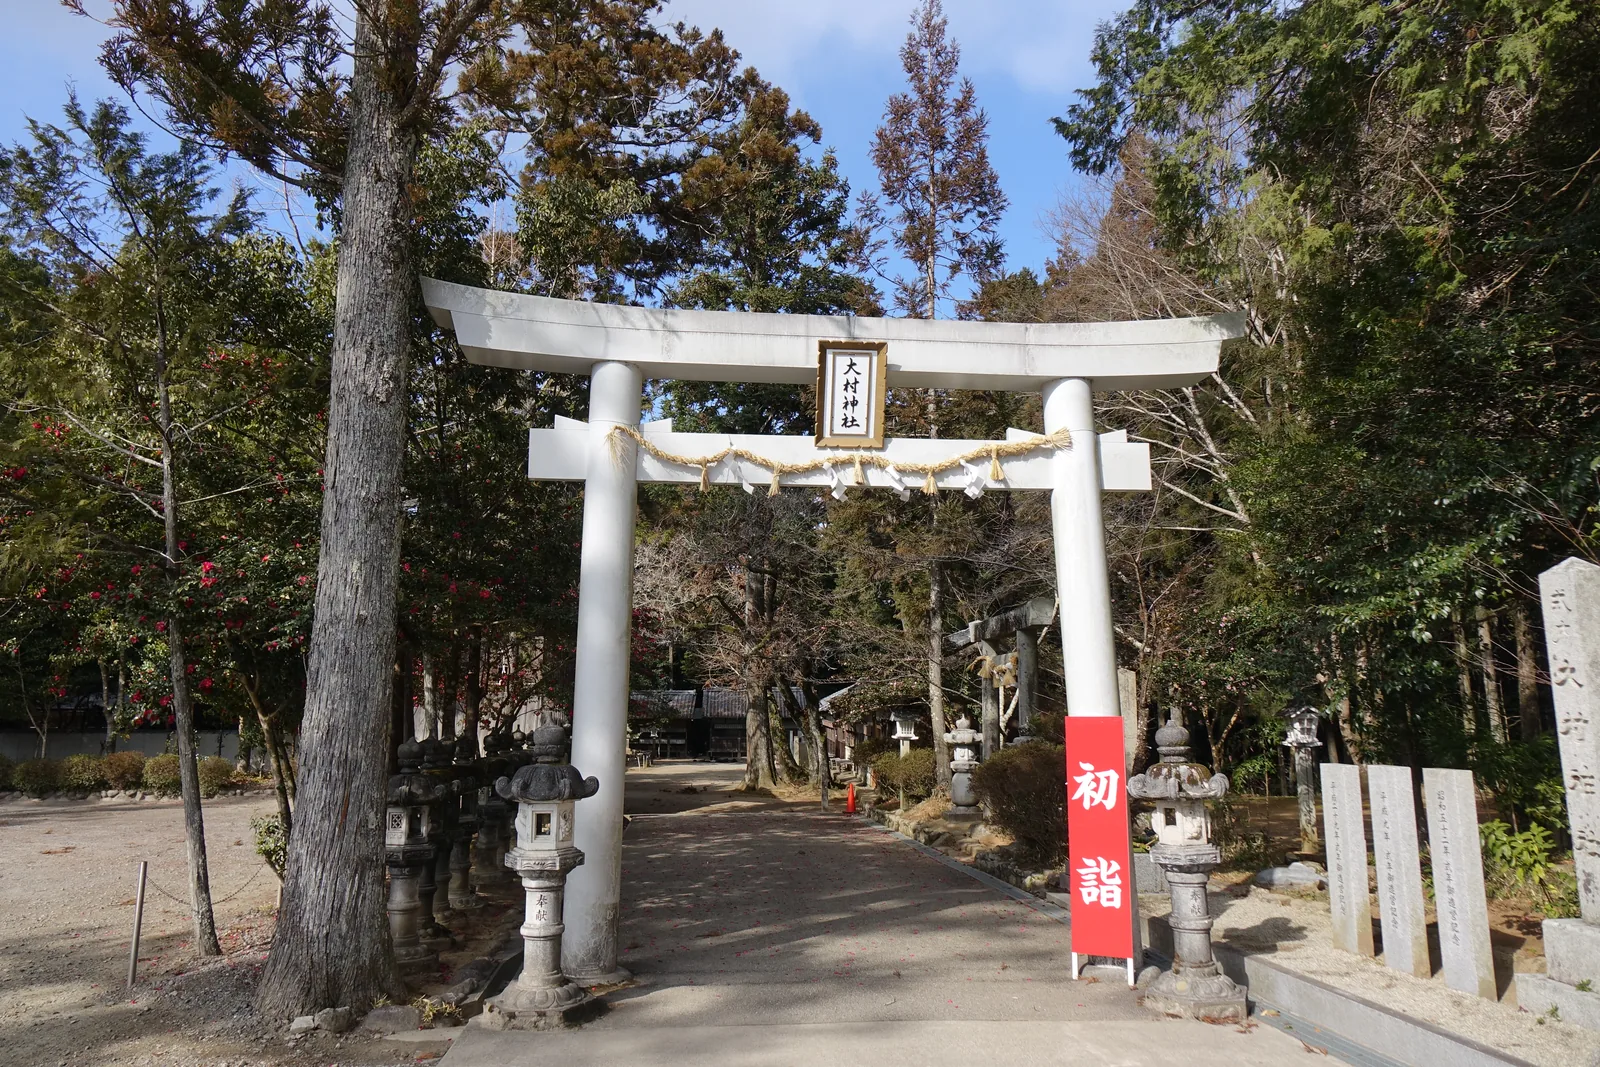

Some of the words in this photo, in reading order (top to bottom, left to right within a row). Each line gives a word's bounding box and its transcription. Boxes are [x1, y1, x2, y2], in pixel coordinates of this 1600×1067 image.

[840, 357, 862, 429] 大村神社
[1071, 761, 1122, 910] 初詣
[535, 894, 548, 922] 奉献
